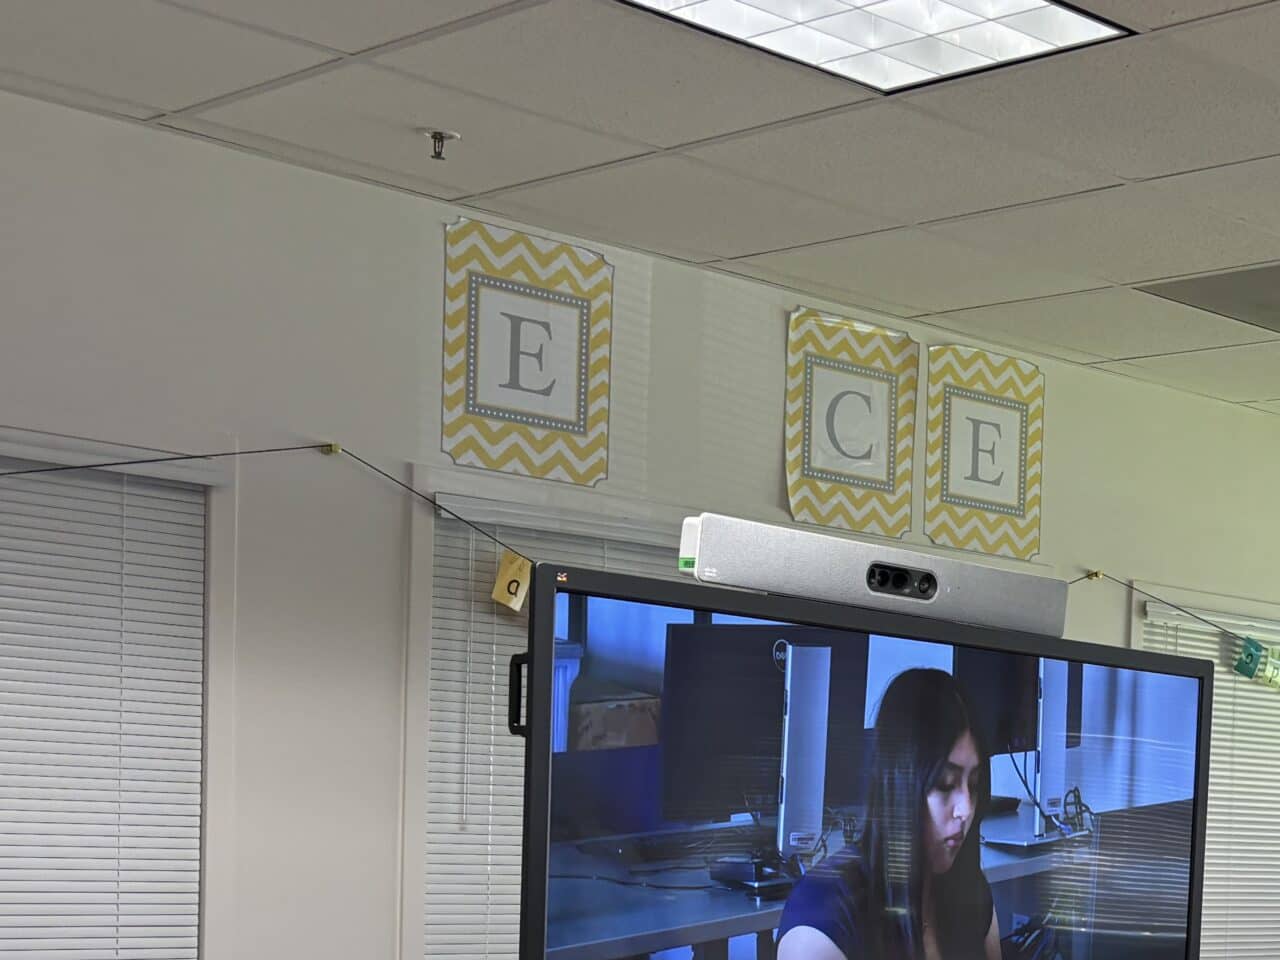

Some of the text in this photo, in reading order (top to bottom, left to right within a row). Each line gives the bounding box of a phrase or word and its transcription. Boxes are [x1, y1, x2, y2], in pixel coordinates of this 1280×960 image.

[498, 311, 1004, 486] E C E
[507, 579, 520, 597] a
